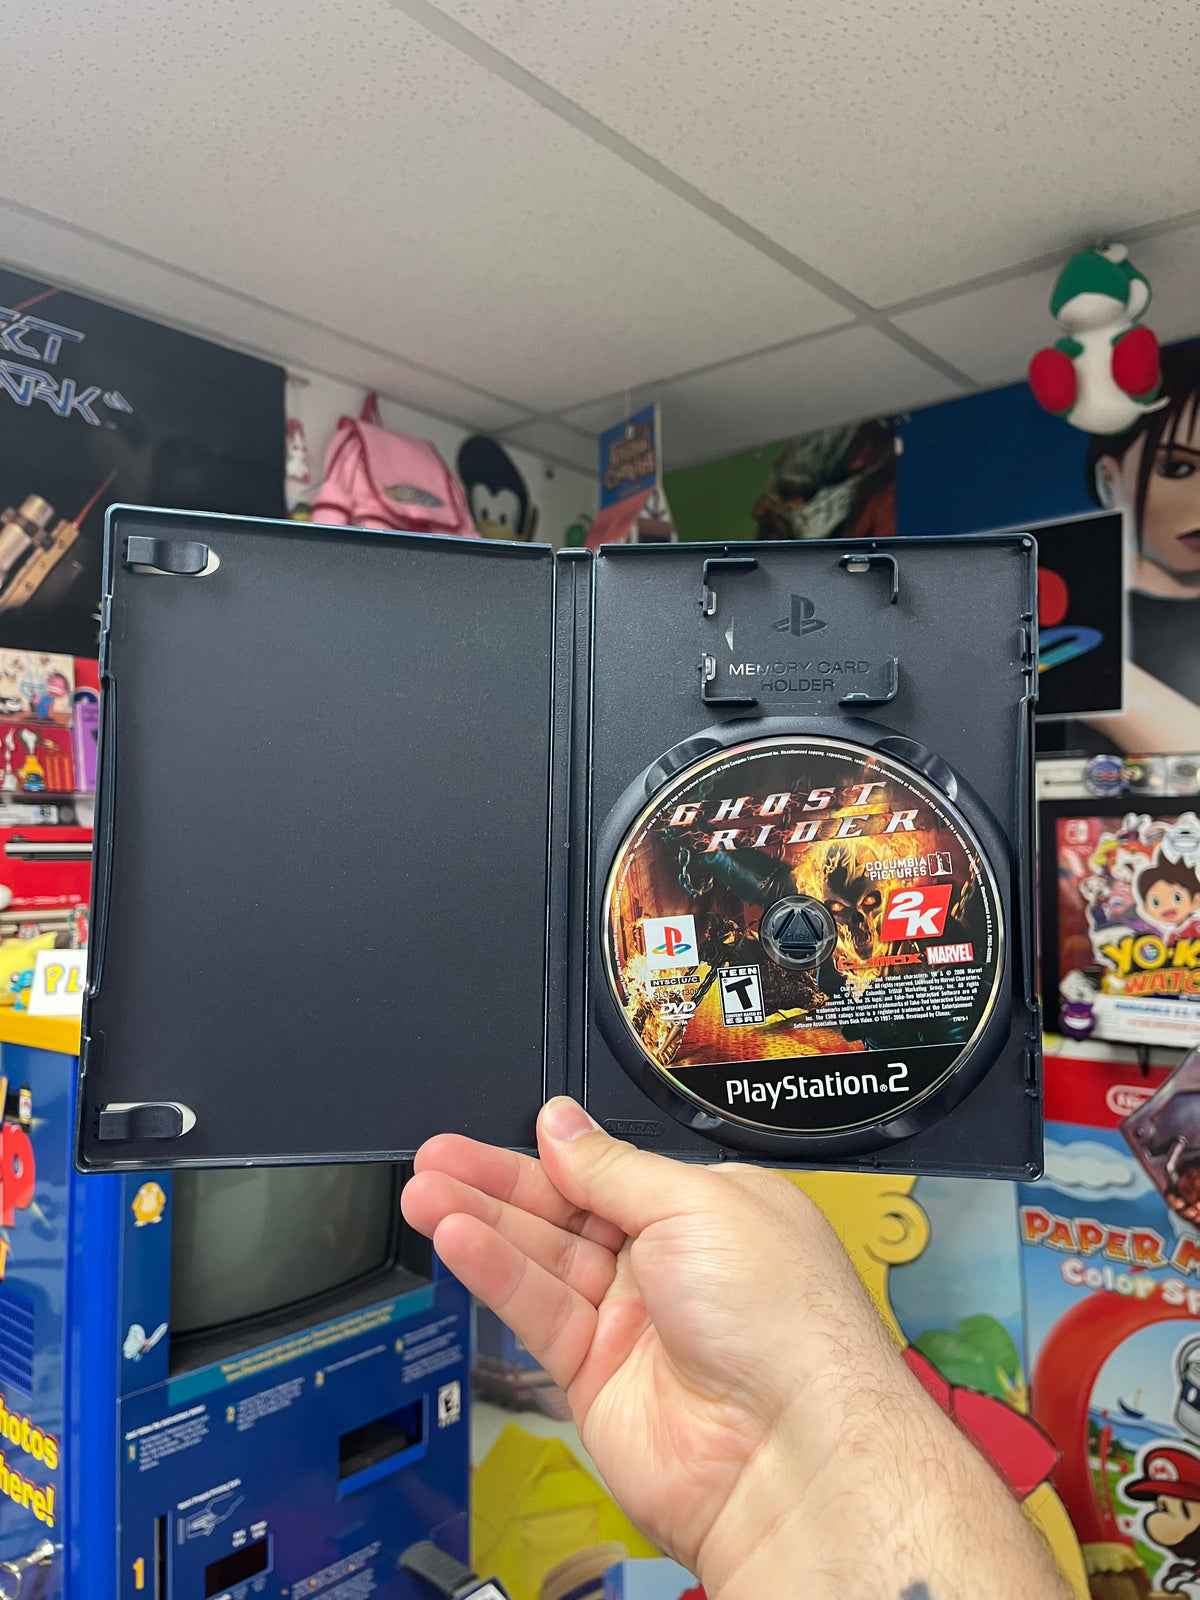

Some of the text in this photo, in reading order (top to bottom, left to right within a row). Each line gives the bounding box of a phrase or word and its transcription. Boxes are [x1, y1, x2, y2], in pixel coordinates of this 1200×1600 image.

[729, 661, 870, 676] MEMORY CARD
[760, 679, 836, 692] HOLDER
[669, 781, 887, 826] GHOST
[702, 809, 920, 853] RIDER
[865, 856, 928, 872] COLUMBIA
[869, 866, 928, 881] PICTURES
[887, 891, 943, 937] 2K
[927, 943, 973, 965] MARVEL
[720, 966, 758, 977] TEEN
[652, 976, 698, 987] NTSC U/C
[724, 977, 754, 1010] T
[660, 1001, 697, 1015] DVD
[725, 1015, 763, 1025] ESRB
[1020, 1205, 1168, 1271] PAPER
[132, 1557, 145, 1590] 1
